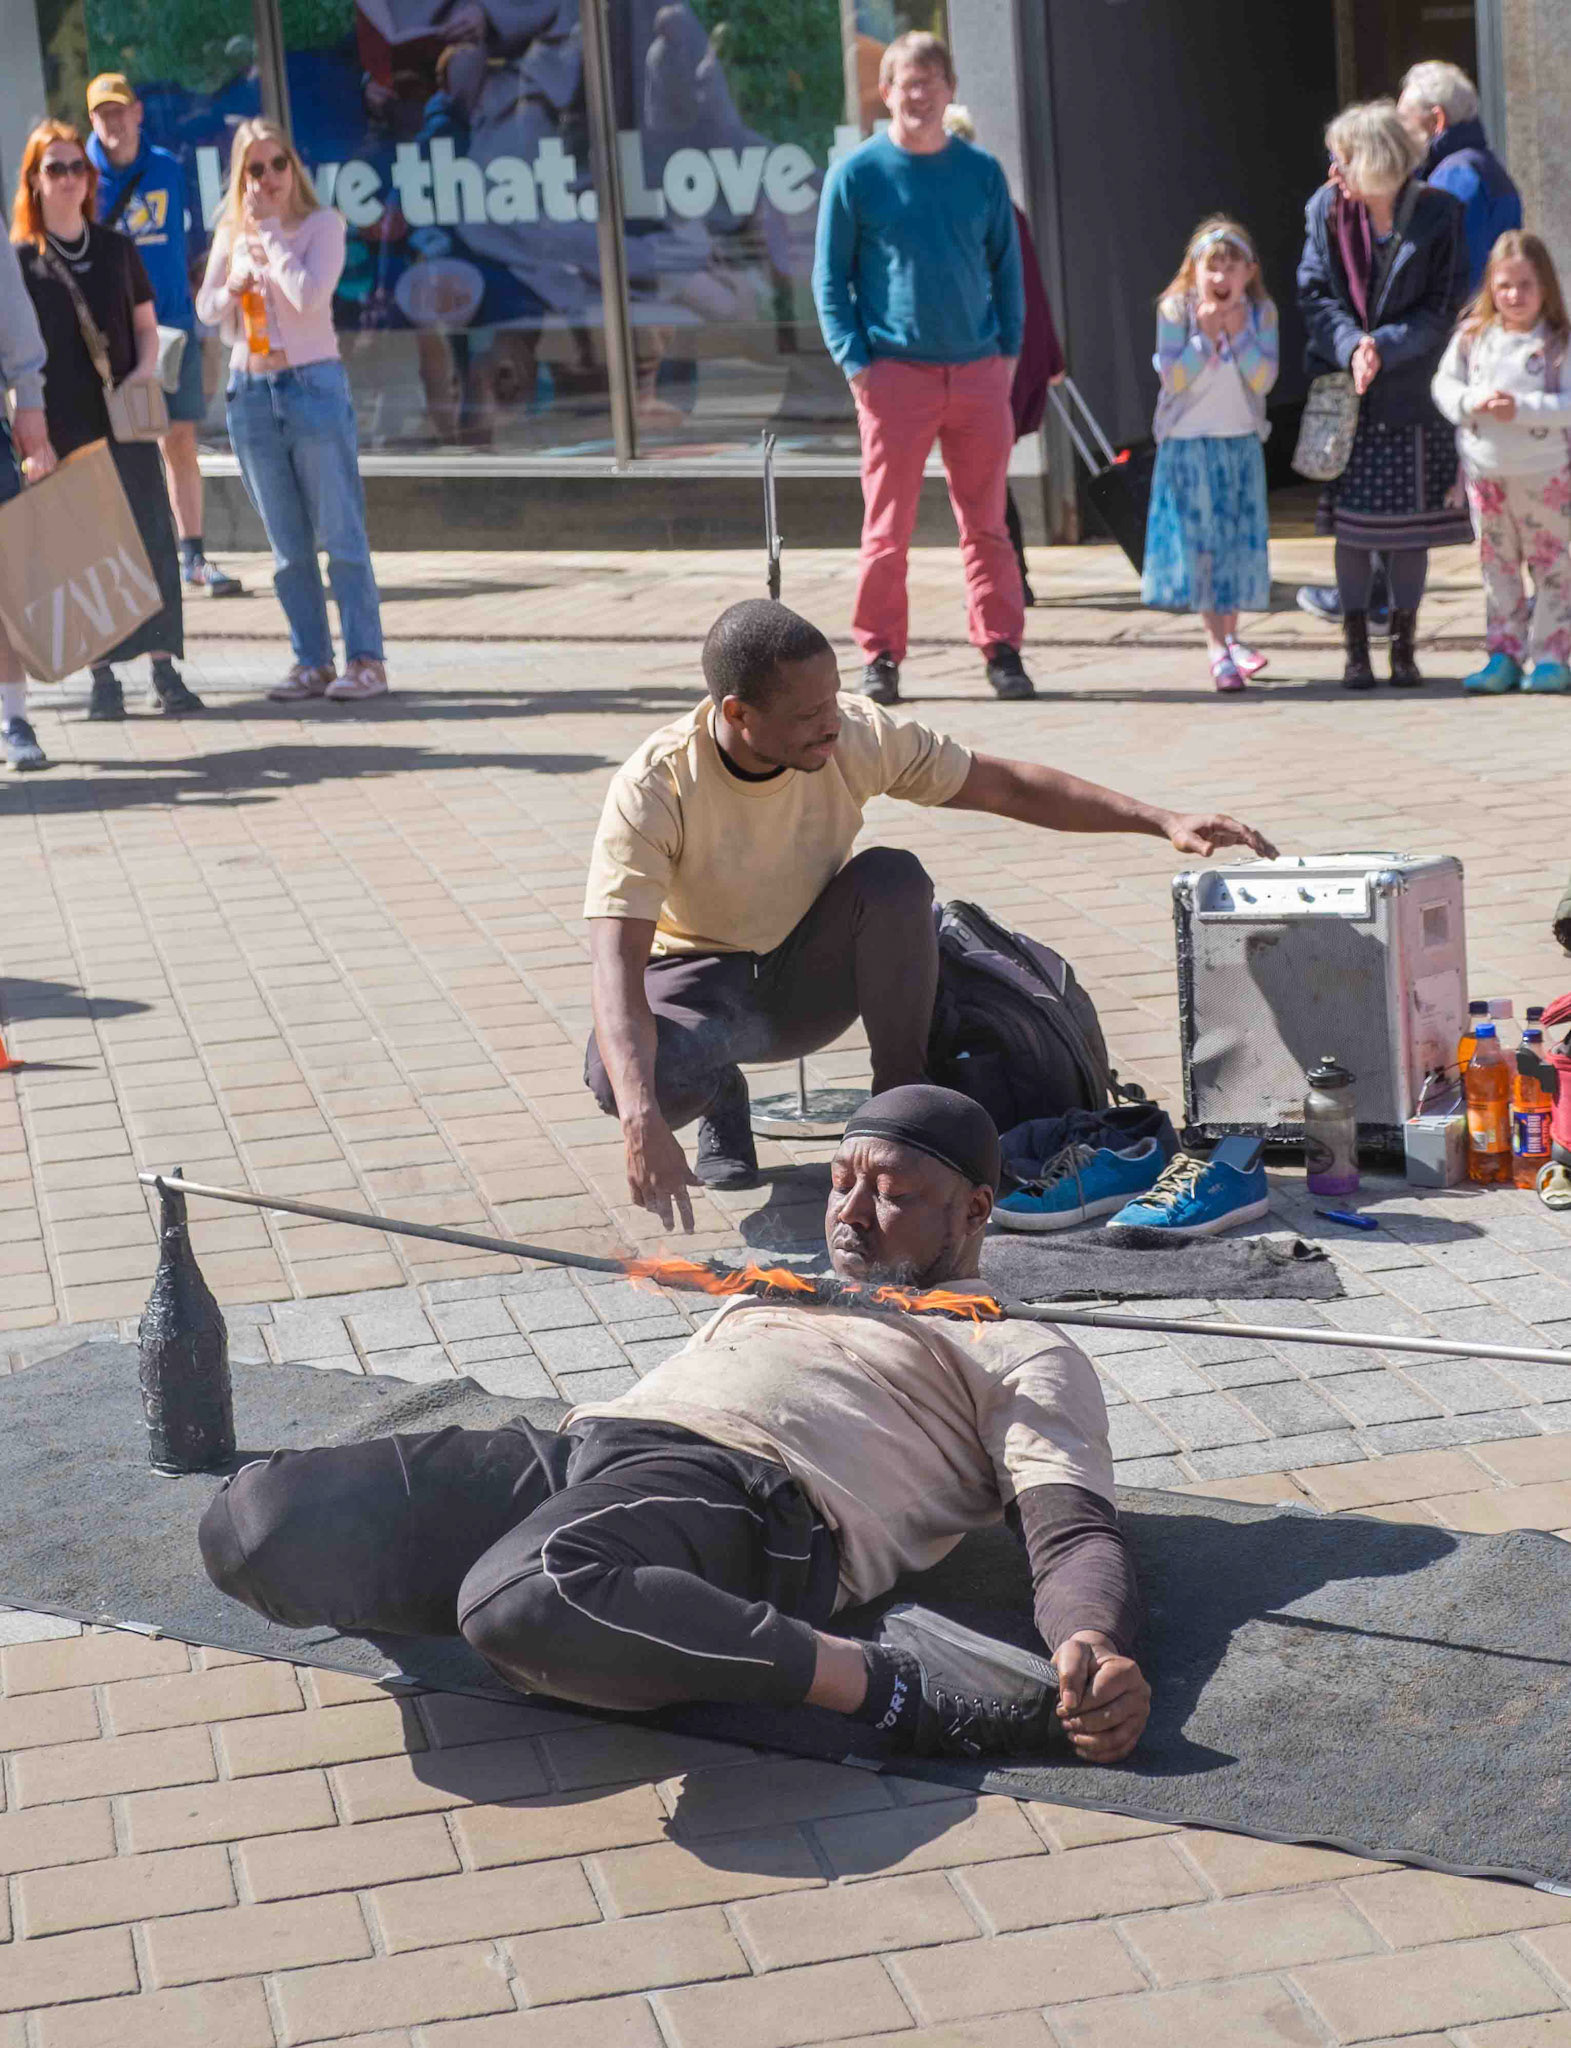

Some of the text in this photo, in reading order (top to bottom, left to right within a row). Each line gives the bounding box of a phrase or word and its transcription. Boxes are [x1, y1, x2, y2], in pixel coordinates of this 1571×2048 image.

[196, 146, 384, 231] Le
[391, 137, 597, 226] that.
[617, 130, 819, 219] Love
